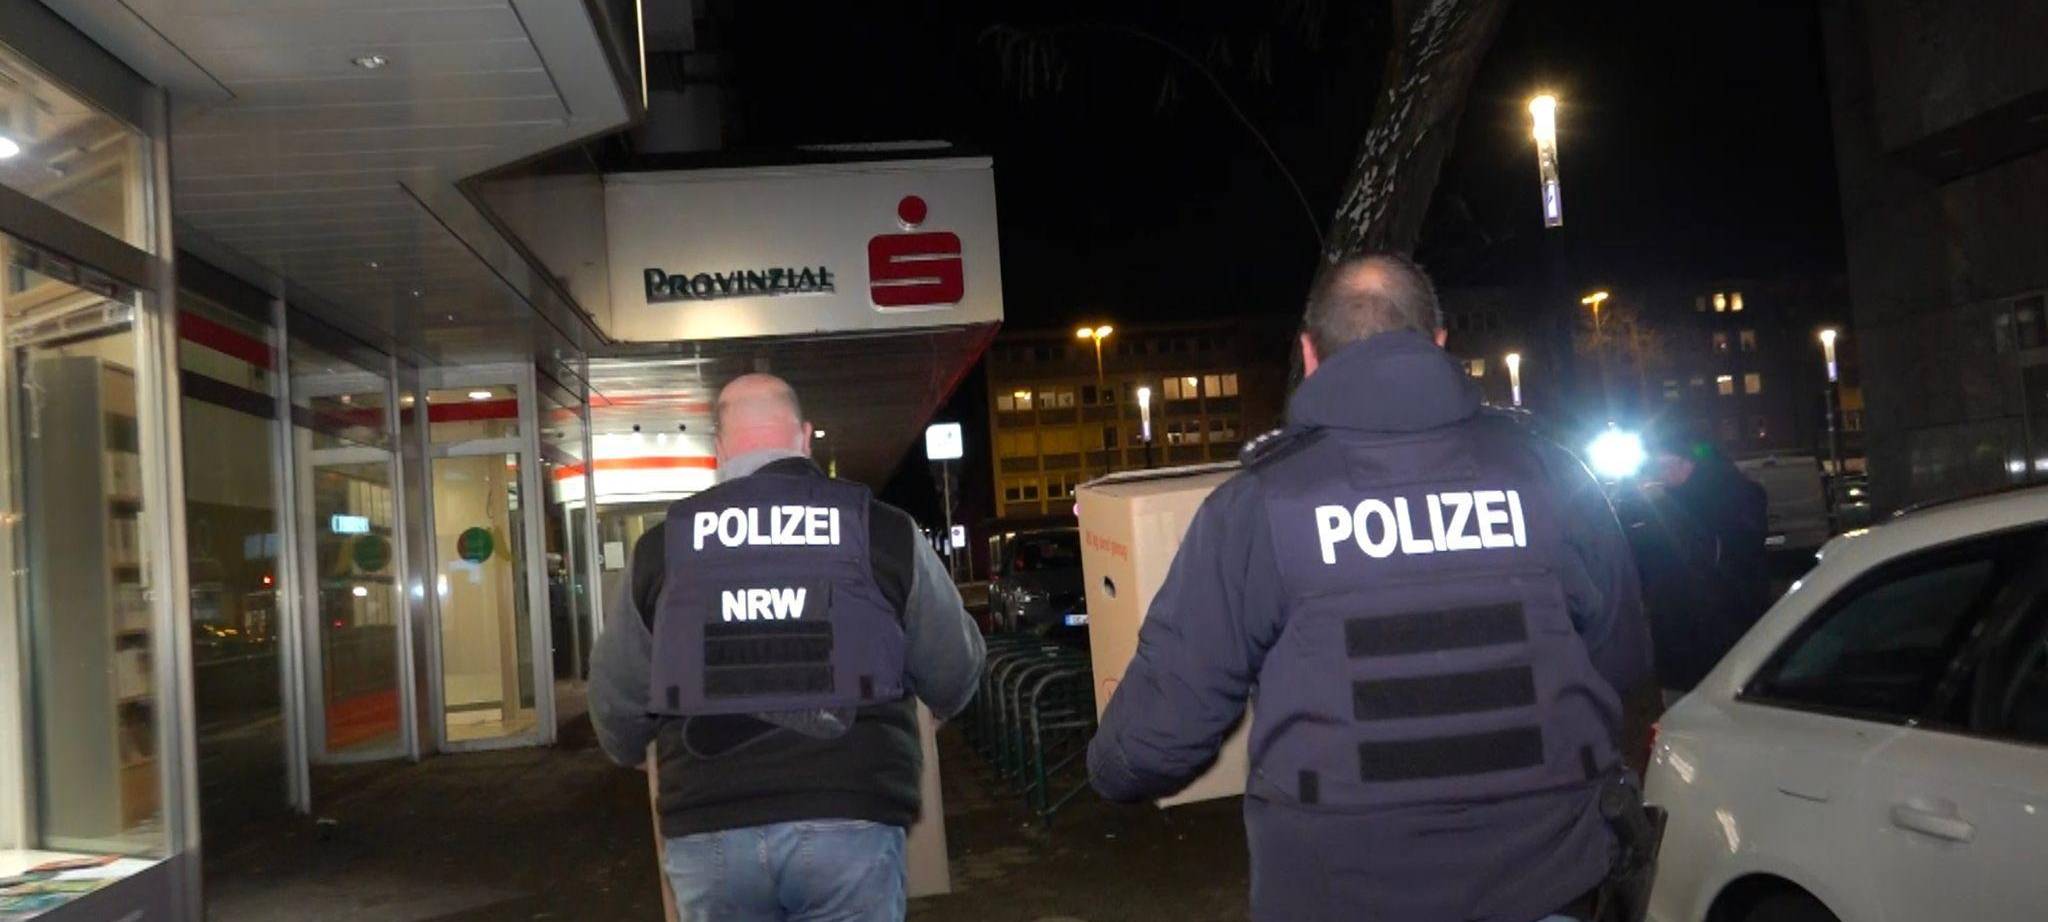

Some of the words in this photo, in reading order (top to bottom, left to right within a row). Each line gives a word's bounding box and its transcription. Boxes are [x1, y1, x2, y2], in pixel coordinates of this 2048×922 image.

[644, 266, 833, 303] PROVINZIAL
[693, 505, 840, 550] POLIZEI
[1315, 490, 1527, 564] POLIZEI
[721, 588, 807, 621] NRW
